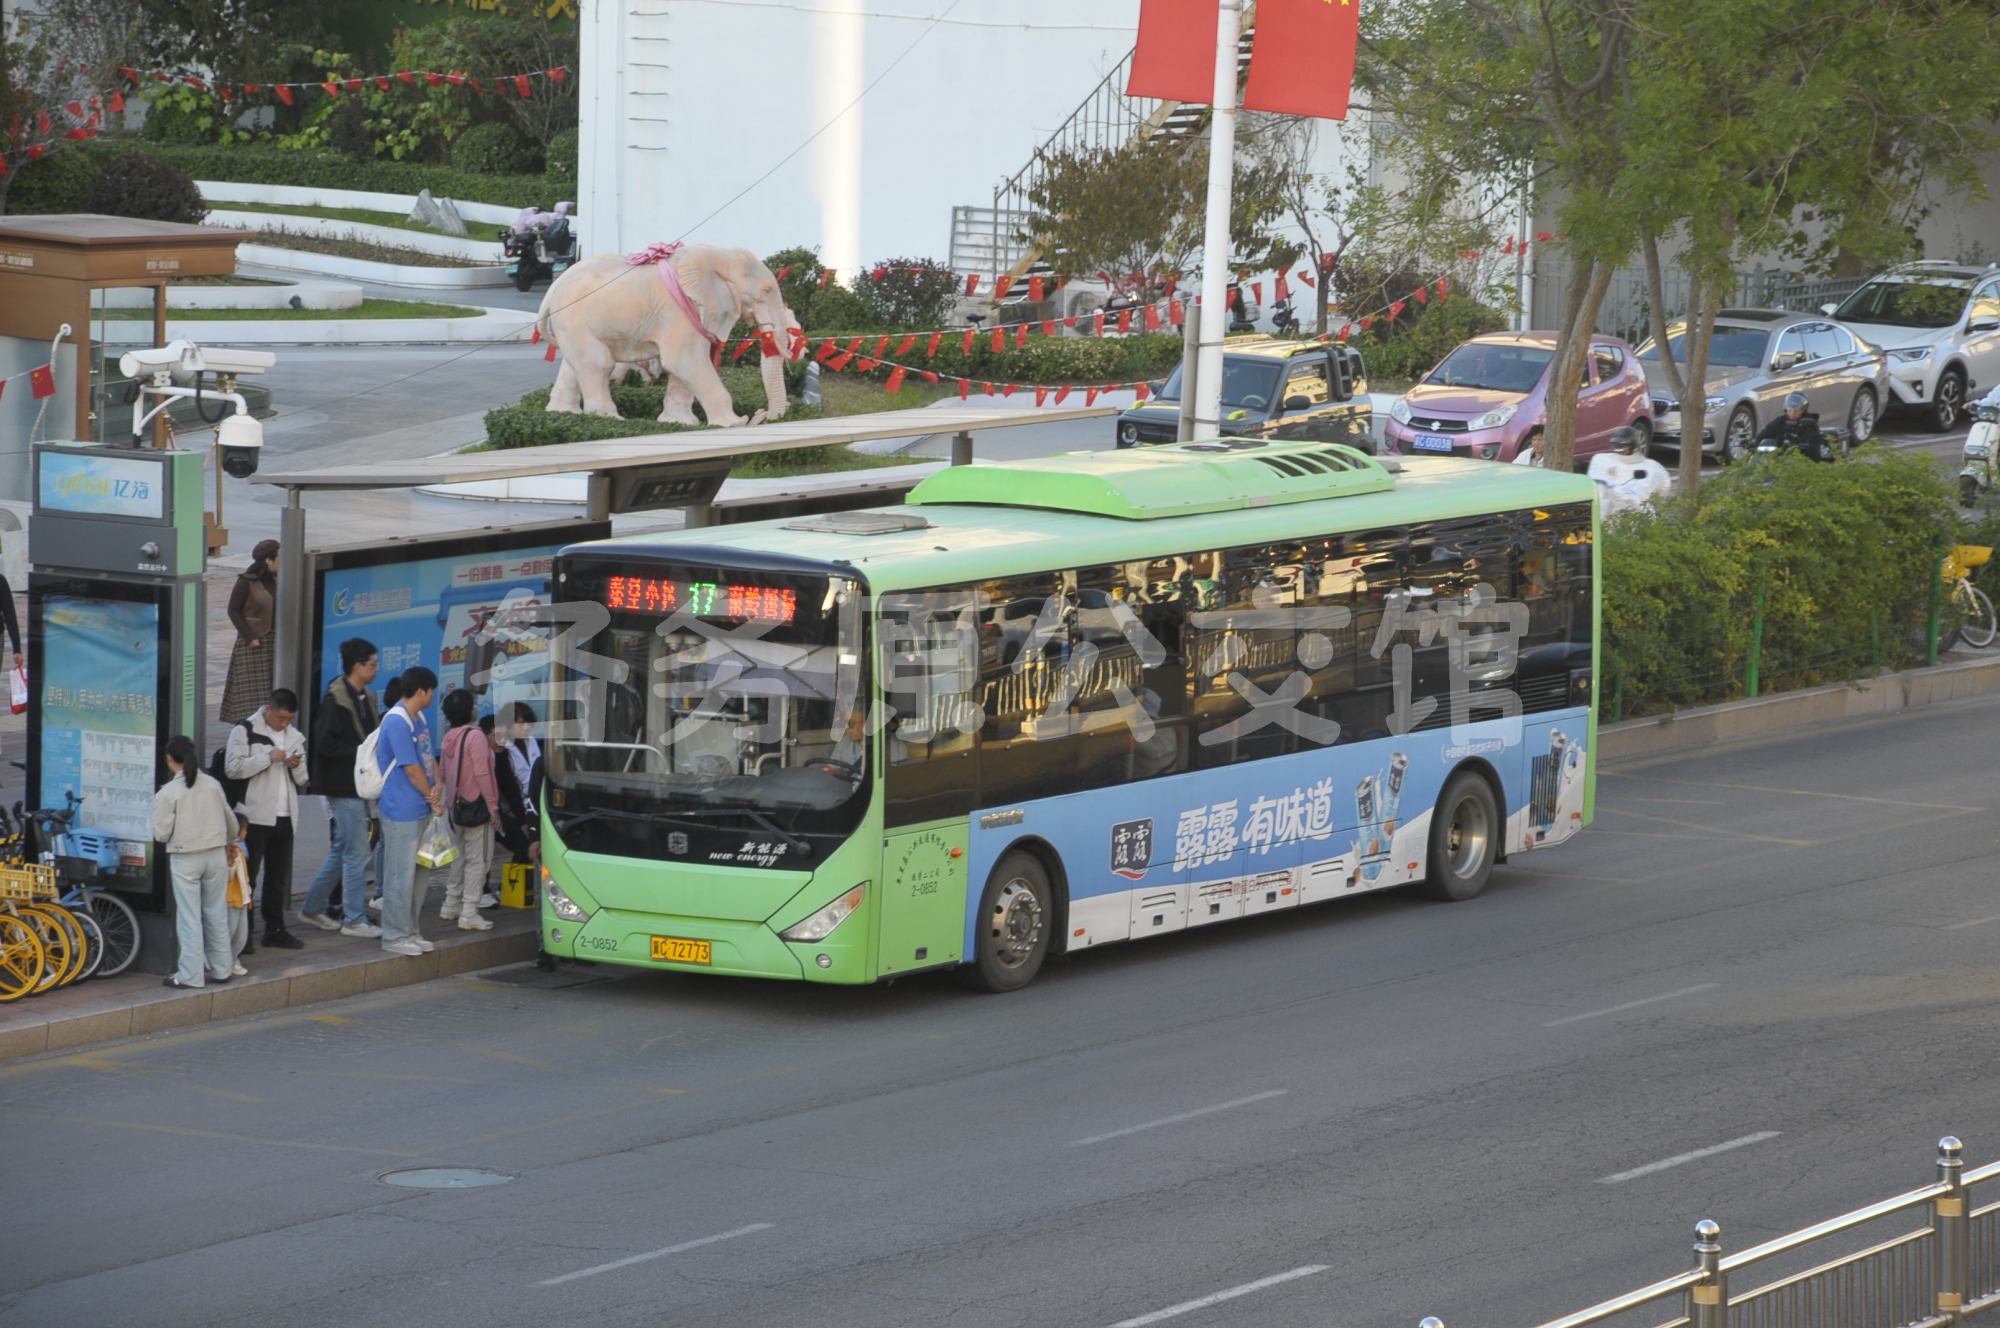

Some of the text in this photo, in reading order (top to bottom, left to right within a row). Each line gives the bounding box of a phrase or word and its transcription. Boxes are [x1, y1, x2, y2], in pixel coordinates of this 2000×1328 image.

[457, 565, 503, 582] 一份善意
[689, 582, 717, 614] 17
[46, 684, 153, 716] 坚持以人民为中心的发展思想
[739, 841, 789, 855] 新能源
[709, 852, 779, 867] new energy
[911, 880, 939, 898] 2-0852
[579, 935, 618, 952] 2-0852
